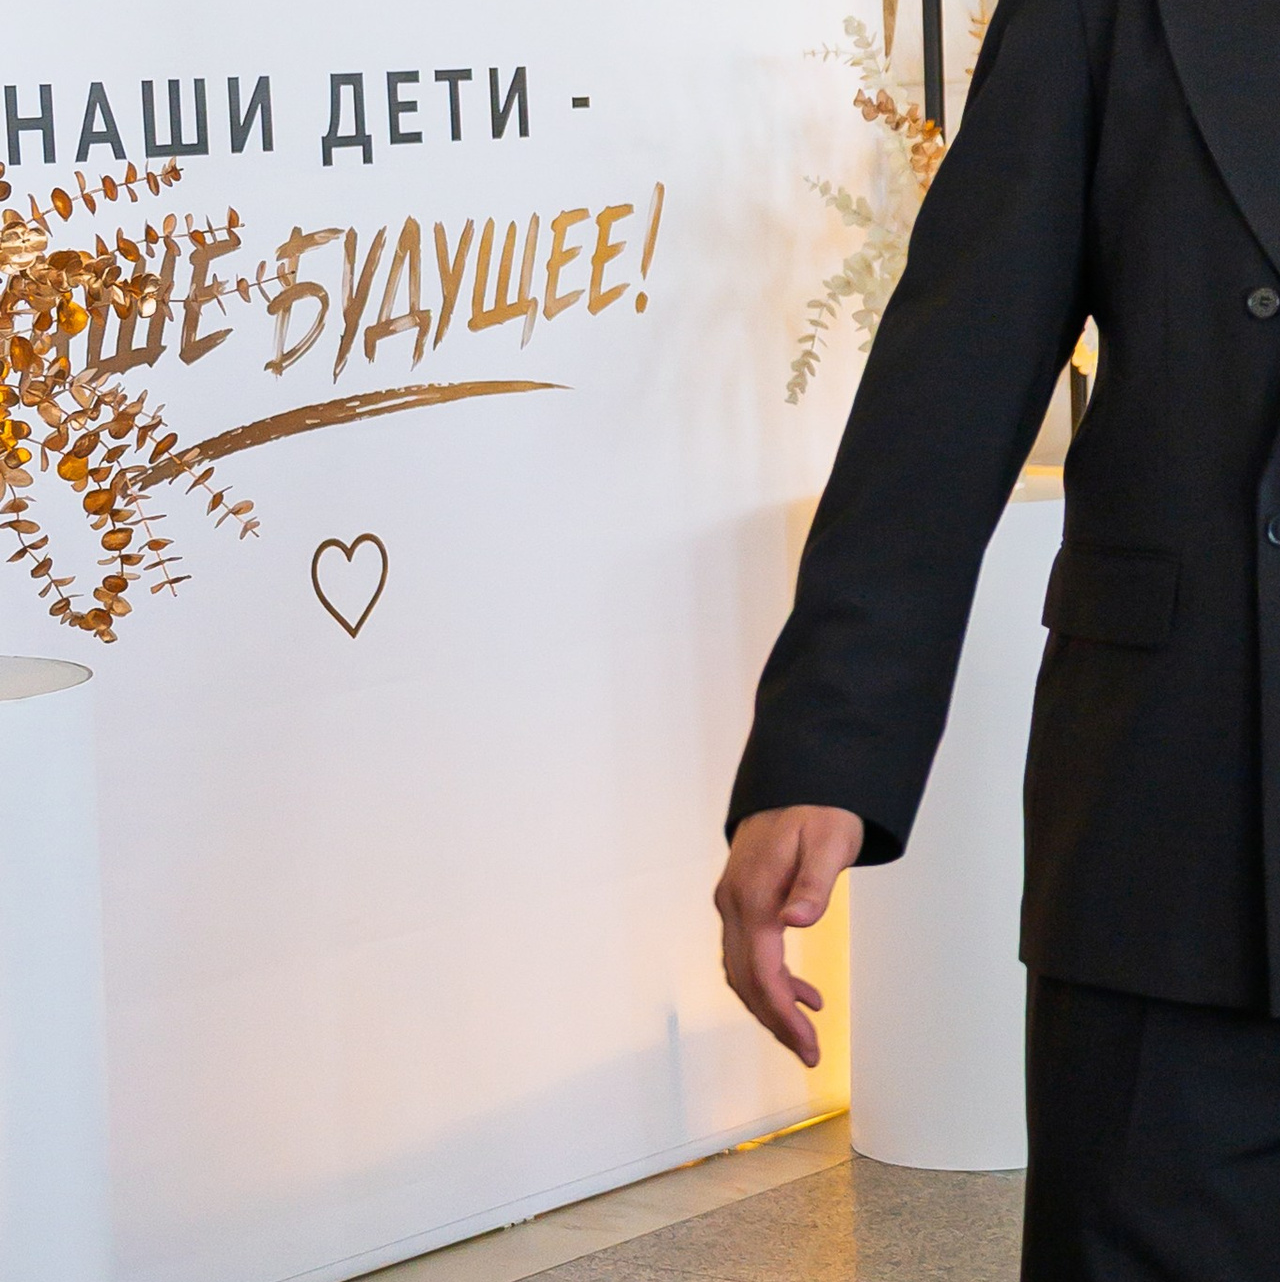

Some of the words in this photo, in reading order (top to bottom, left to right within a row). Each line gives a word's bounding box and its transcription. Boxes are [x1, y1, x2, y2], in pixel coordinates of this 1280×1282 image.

[3, 75, 274, 166] НАШИ
[321, 66, 530, 167] ДЕТИ
[264, 181, 665, 385] БУДУЩЕЕ!
